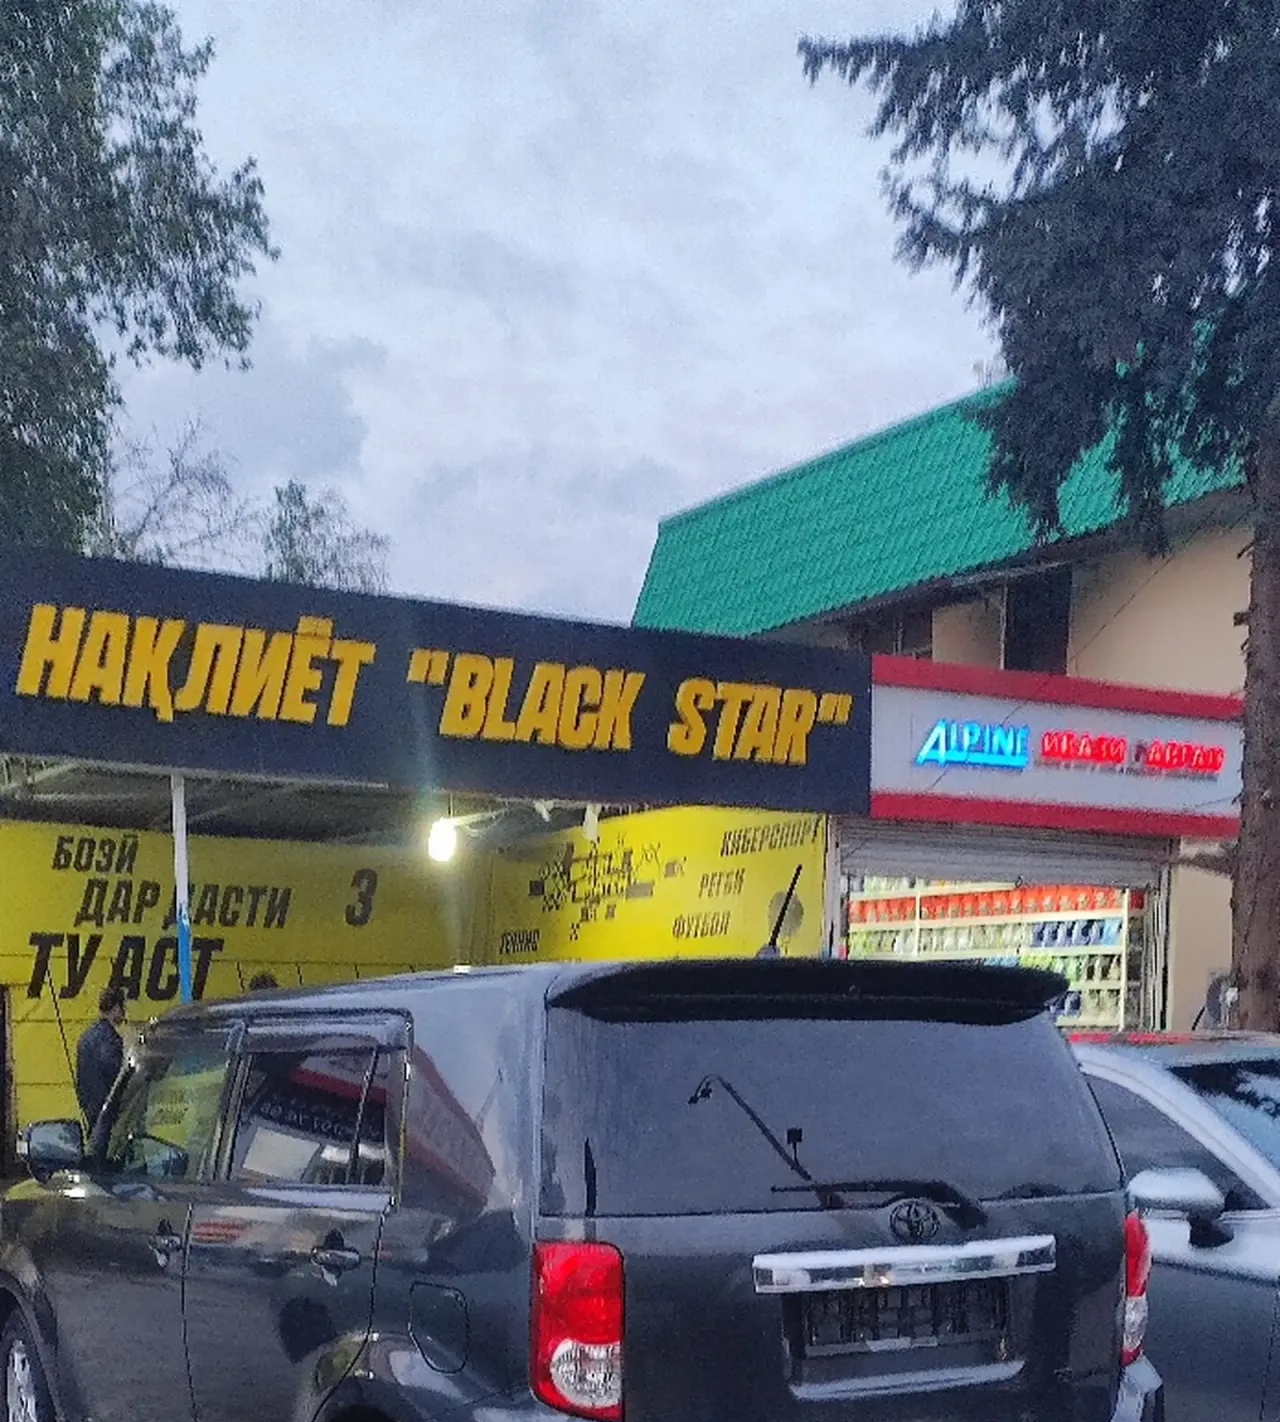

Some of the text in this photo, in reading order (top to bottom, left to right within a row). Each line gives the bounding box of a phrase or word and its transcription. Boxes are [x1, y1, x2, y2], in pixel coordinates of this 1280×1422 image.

[15, 603, 852, 765] НАҚЛИЁТ "BLACK STAR"
[915, 718, 1030, 768] ALPINE
[720, 815, 822, 857] КИБЕРСПОРТ
[75, 878, 160, 928] ДАР
[672, 910, 730, 941] ФУТБОЛ
[27, 932, 224, 1001] ТУ АСТ
